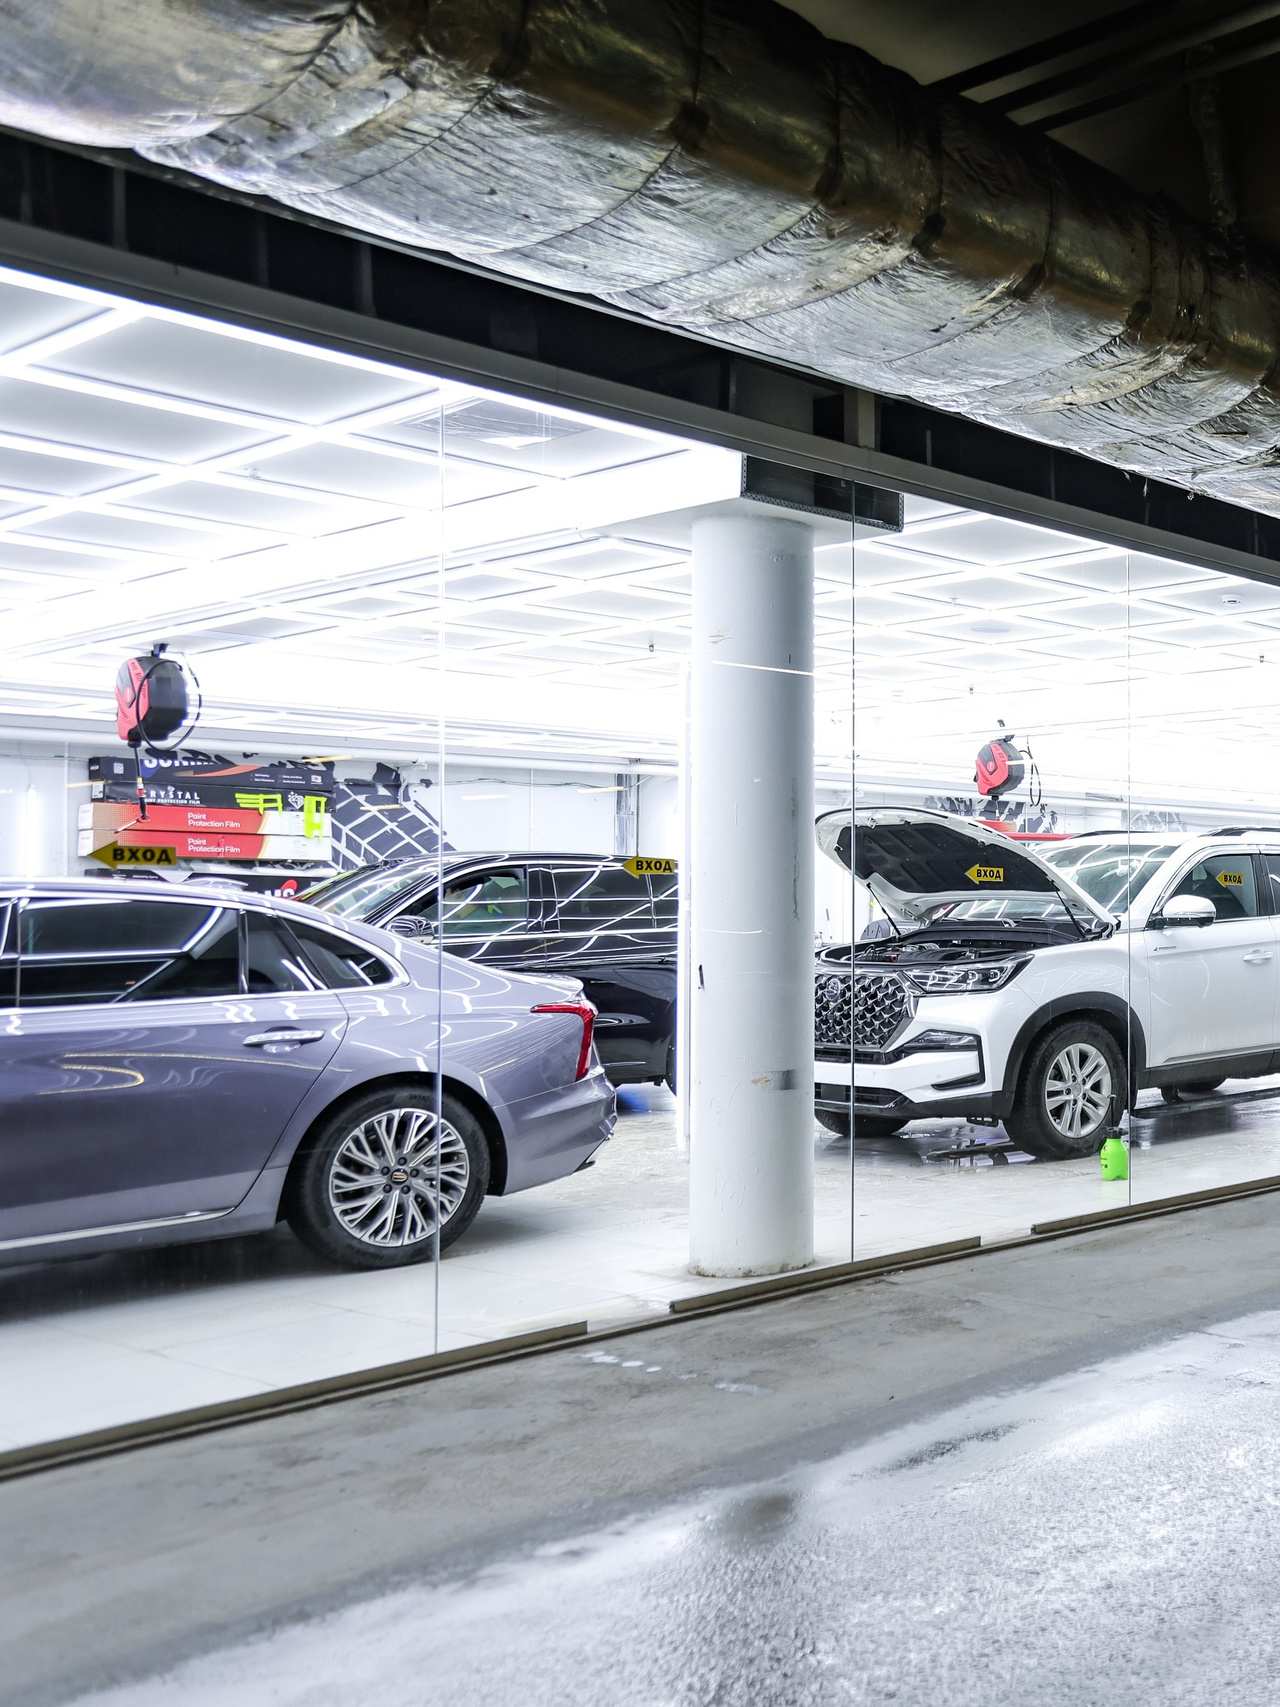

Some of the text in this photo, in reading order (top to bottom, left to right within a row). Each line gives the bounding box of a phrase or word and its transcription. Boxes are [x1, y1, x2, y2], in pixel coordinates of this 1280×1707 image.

[187, 812, 207, 820] Paint
[187, 820, 224, 828] Protection
[187, 845, 224, 853] Protection
[112, 848, 172, 865] ВХОД
[636, 860, 673, 873] ВХОД
[976, 869, 1002, 880] ВХОД
[1223, 874, 1243, 884] ВХОД
